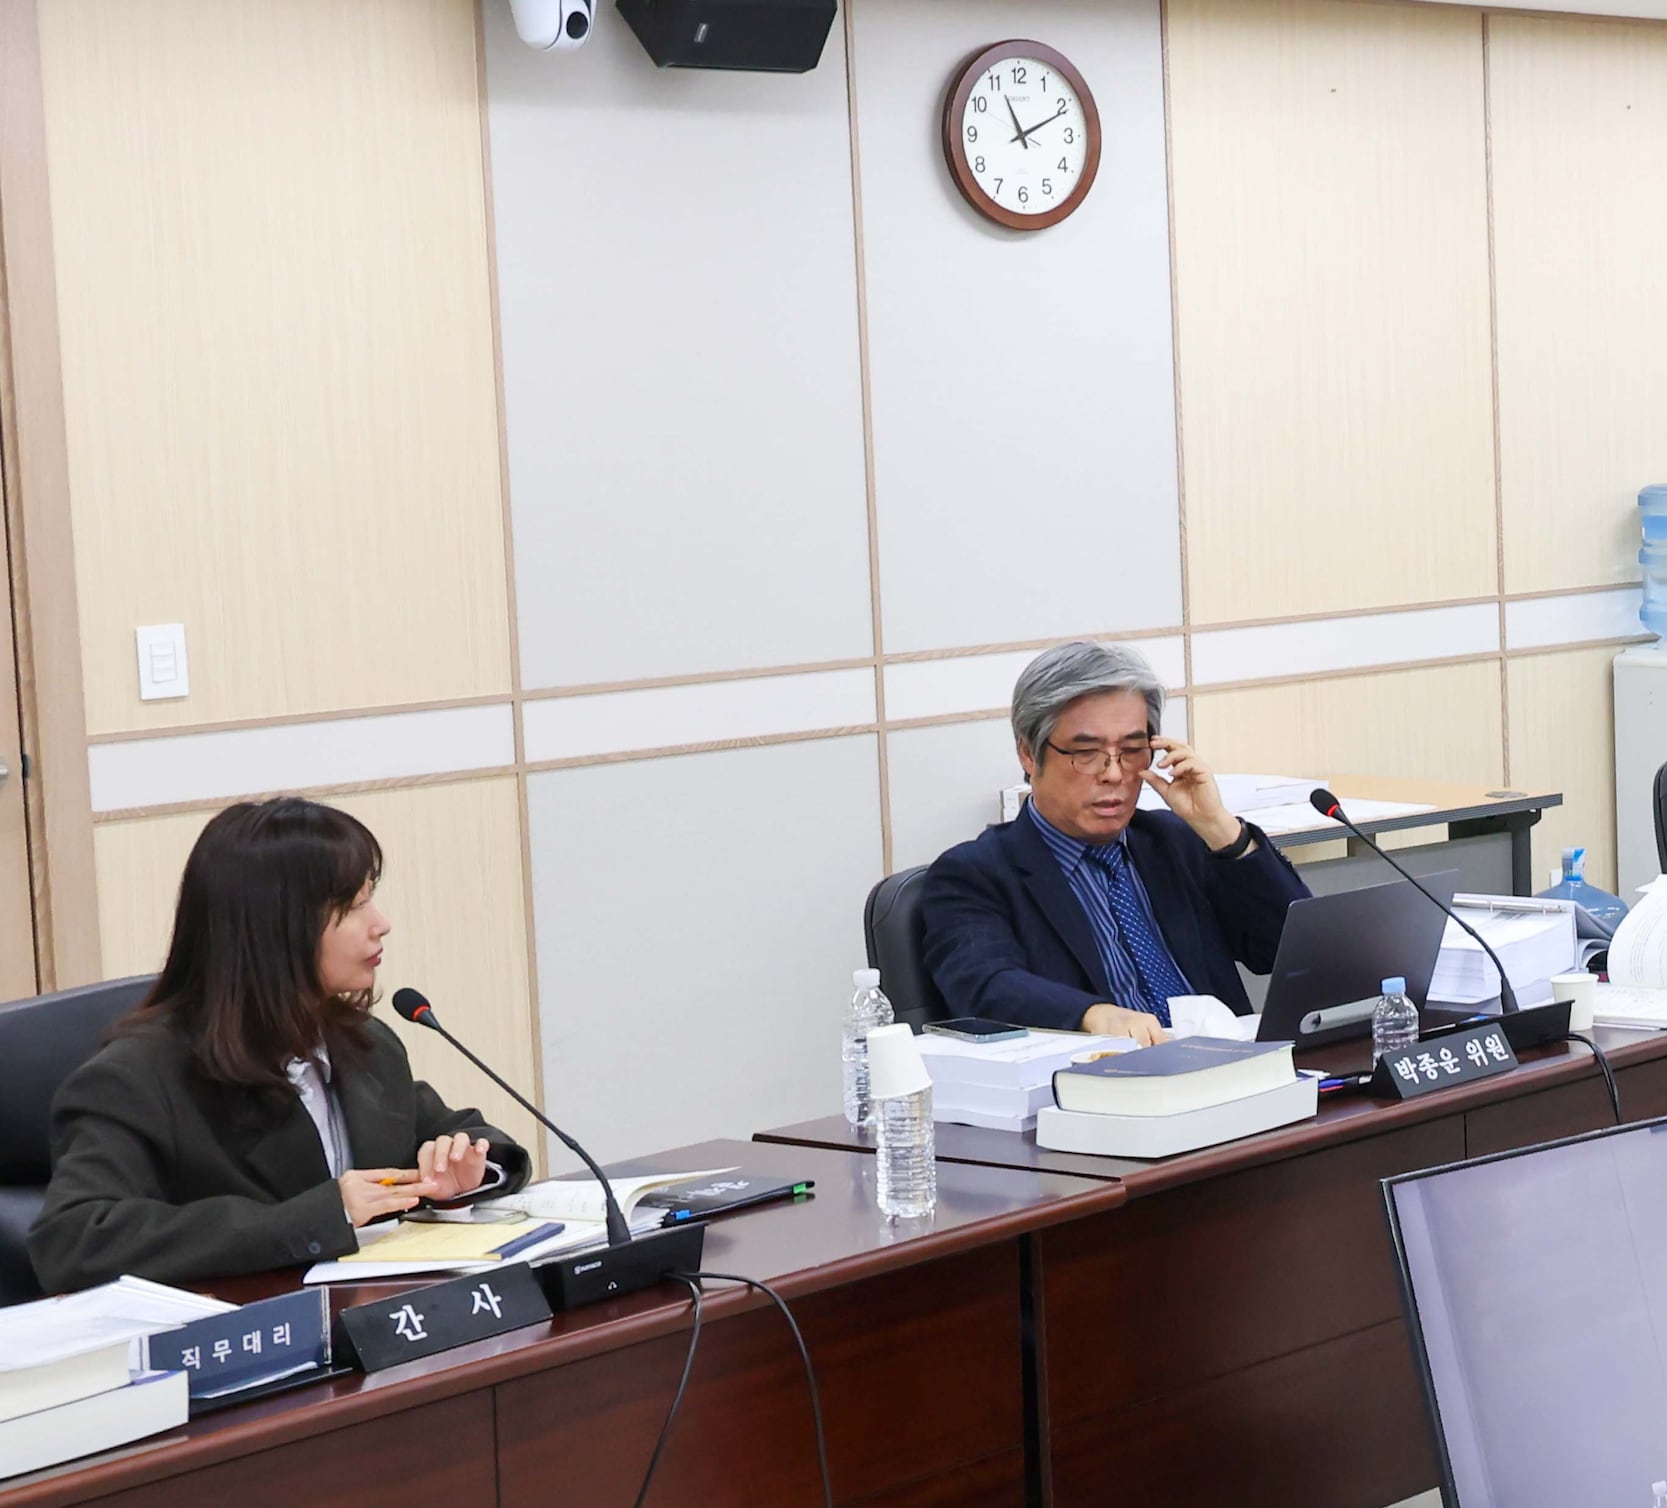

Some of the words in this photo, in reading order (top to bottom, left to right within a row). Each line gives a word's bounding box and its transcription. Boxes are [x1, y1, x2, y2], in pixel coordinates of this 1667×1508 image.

[988, 74, 1001, 91] 11
[1011, 67, 1027, 84] 12
[1040, 76, 1046, 93] 1
[971, 96, 987, 113] 10
[1056, 98, 1068, 115] 2
[967, 125, 978, 143] 9
[1063, 127, 1074, 144] 3
[975, 156, 986, 173] 8
[1057, 156, 1068, 173] 4
[993, 178, 1004, 194] 7
[1018, 186, 1029, 203] 6
[1042, 178, 1052, 195] 5
[1394, 1047, 1461, 1085] 박종운
[1465, 1033, 1510, 1067] 위원
[180, 1322, 292, 1370] 직무대리
